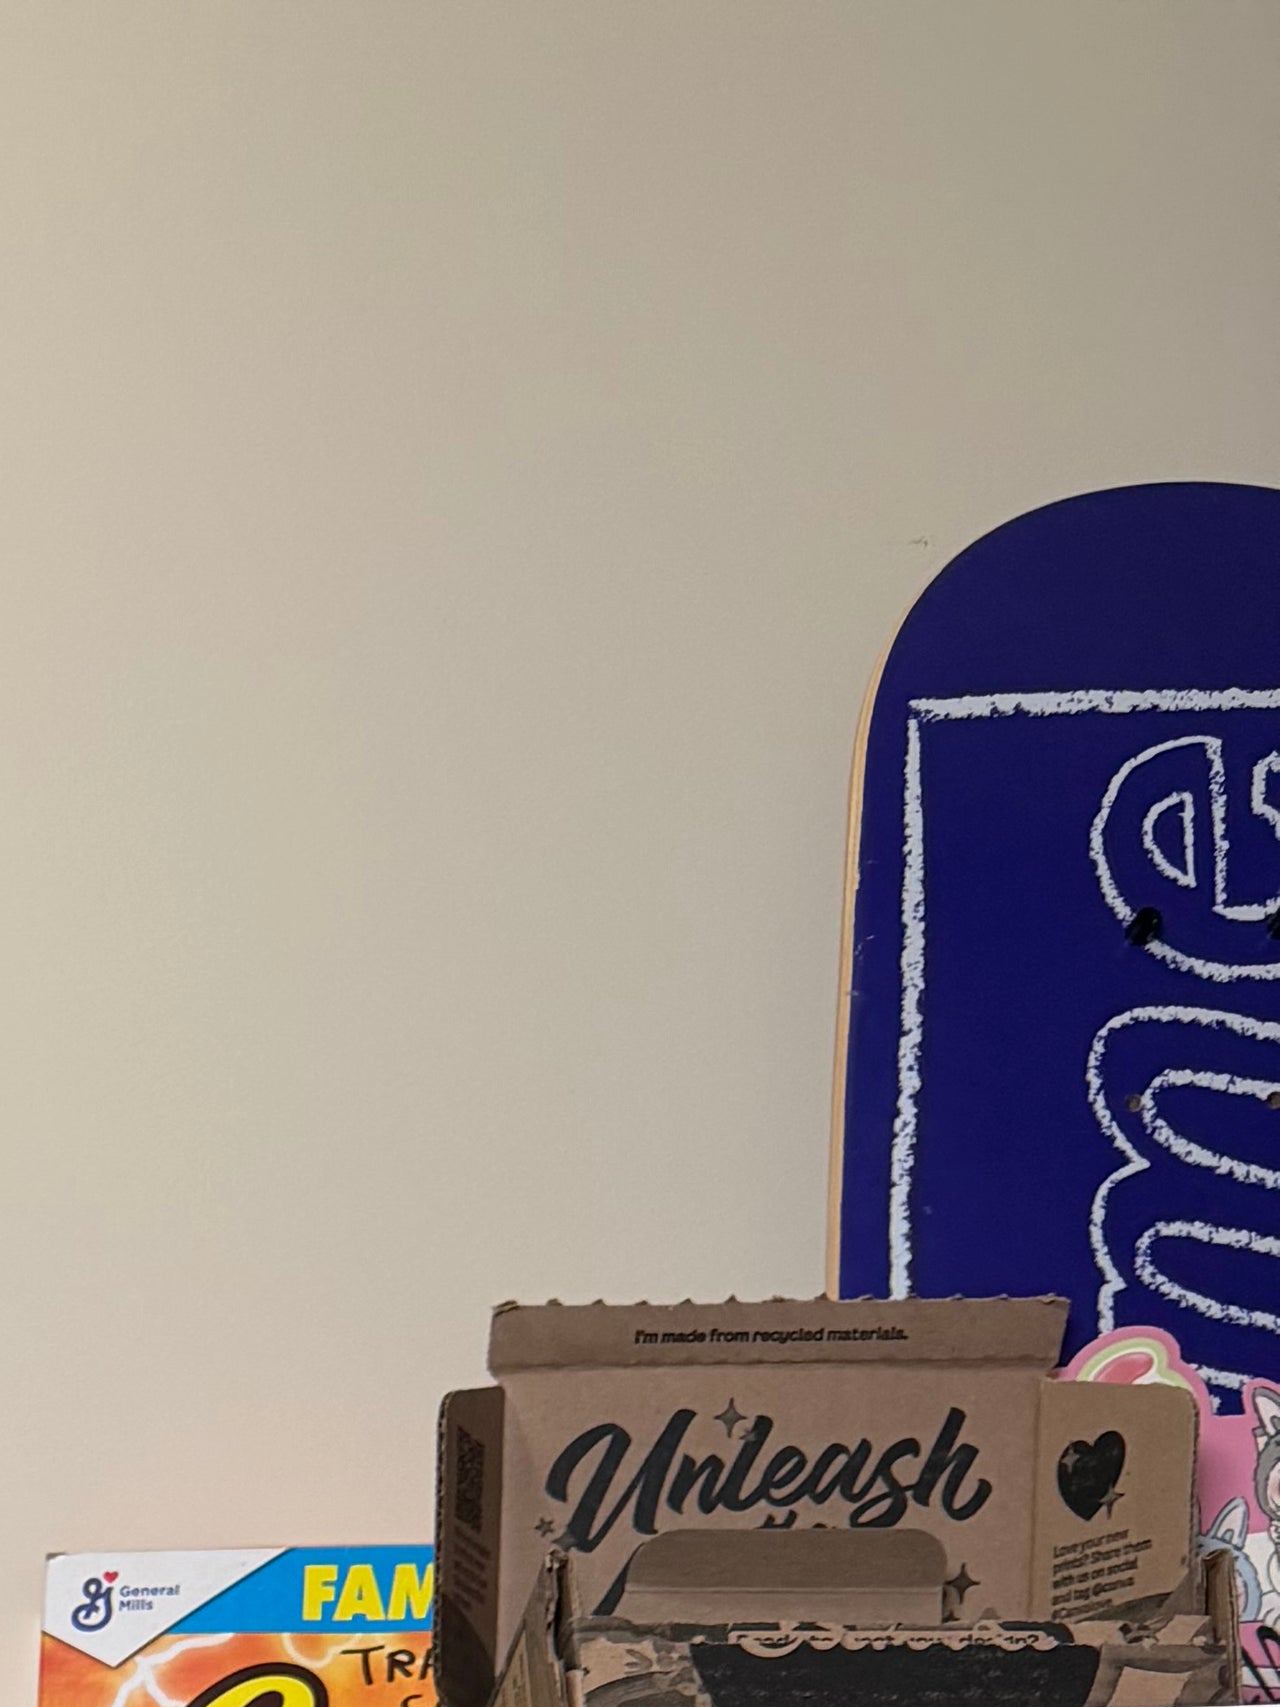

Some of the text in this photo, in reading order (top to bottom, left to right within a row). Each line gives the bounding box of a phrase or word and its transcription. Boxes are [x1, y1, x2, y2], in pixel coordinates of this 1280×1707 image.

[634, 1326, 909, 1345] I'm made from recycled materials.
[545, 1406, 993, 1553] Unleash
[119, 1584, 181, 1599] General
[118, 1599, 154, 1612] Mills
